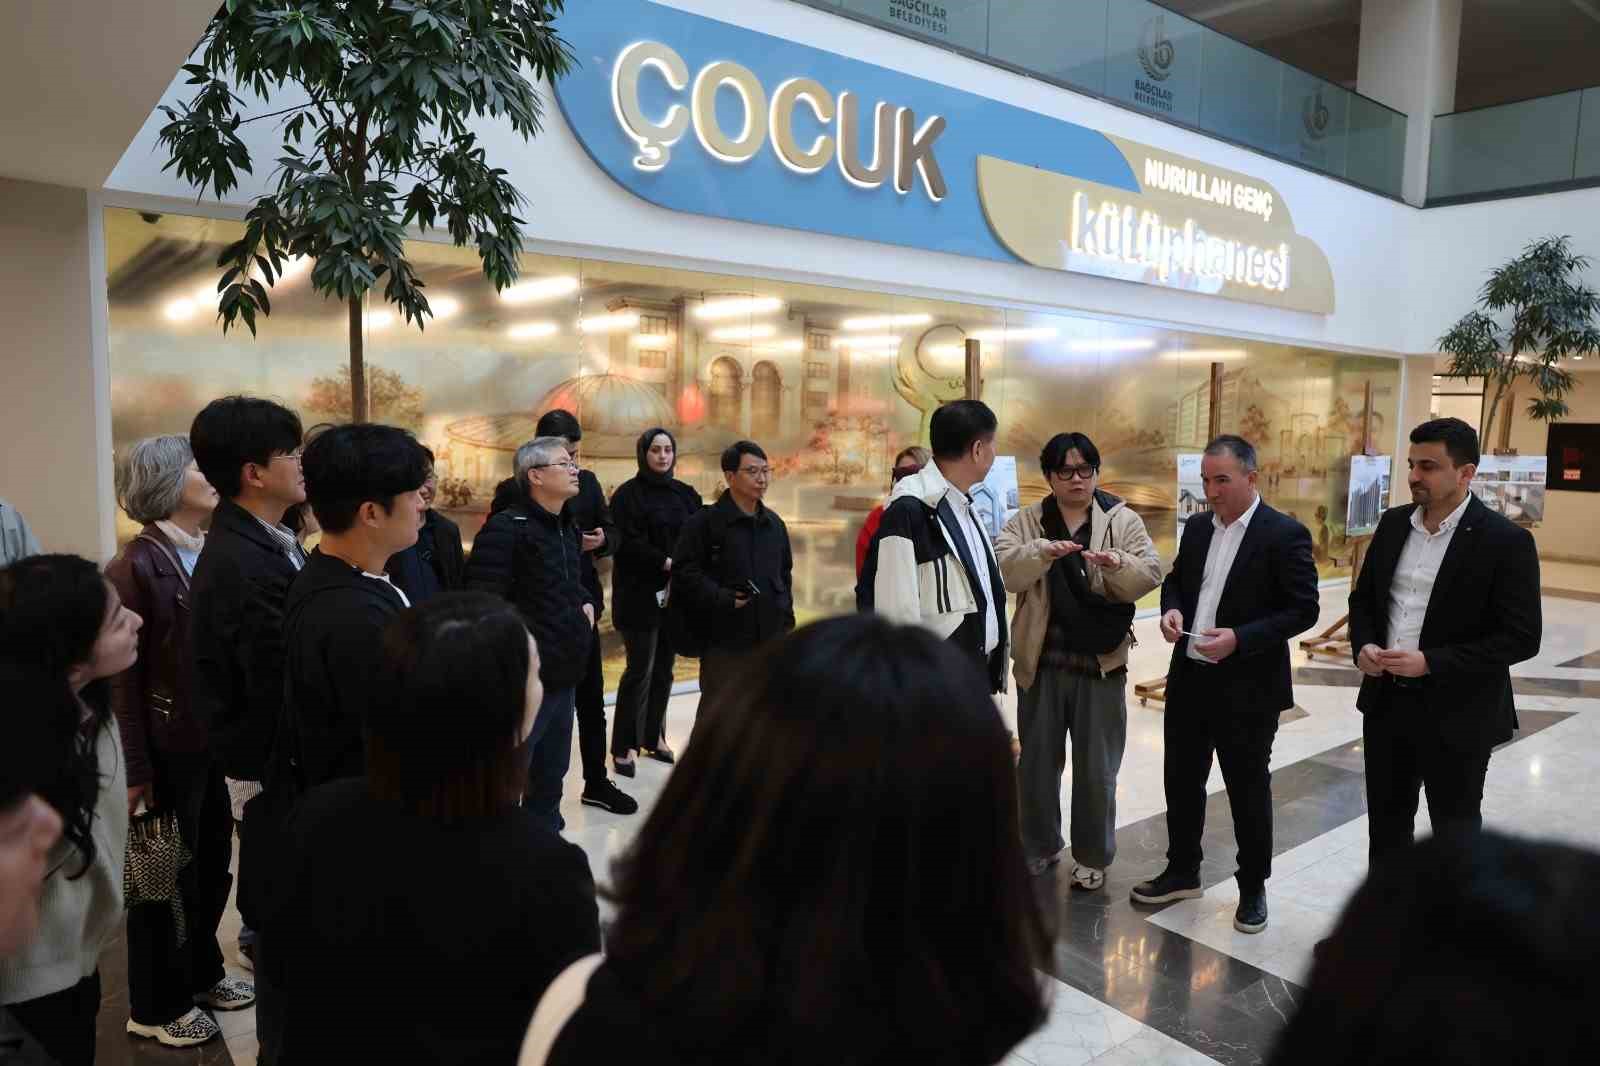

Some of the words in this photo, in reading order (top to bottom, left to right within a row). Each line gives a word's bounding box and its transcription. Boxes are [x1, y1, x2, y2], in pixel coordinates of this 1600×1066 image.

[611, 40, 947, 201] ÇOCUK
[1144, 158, 1231, 207] NURULLAH
[1234, 183, 1273, 222] GENÇ
